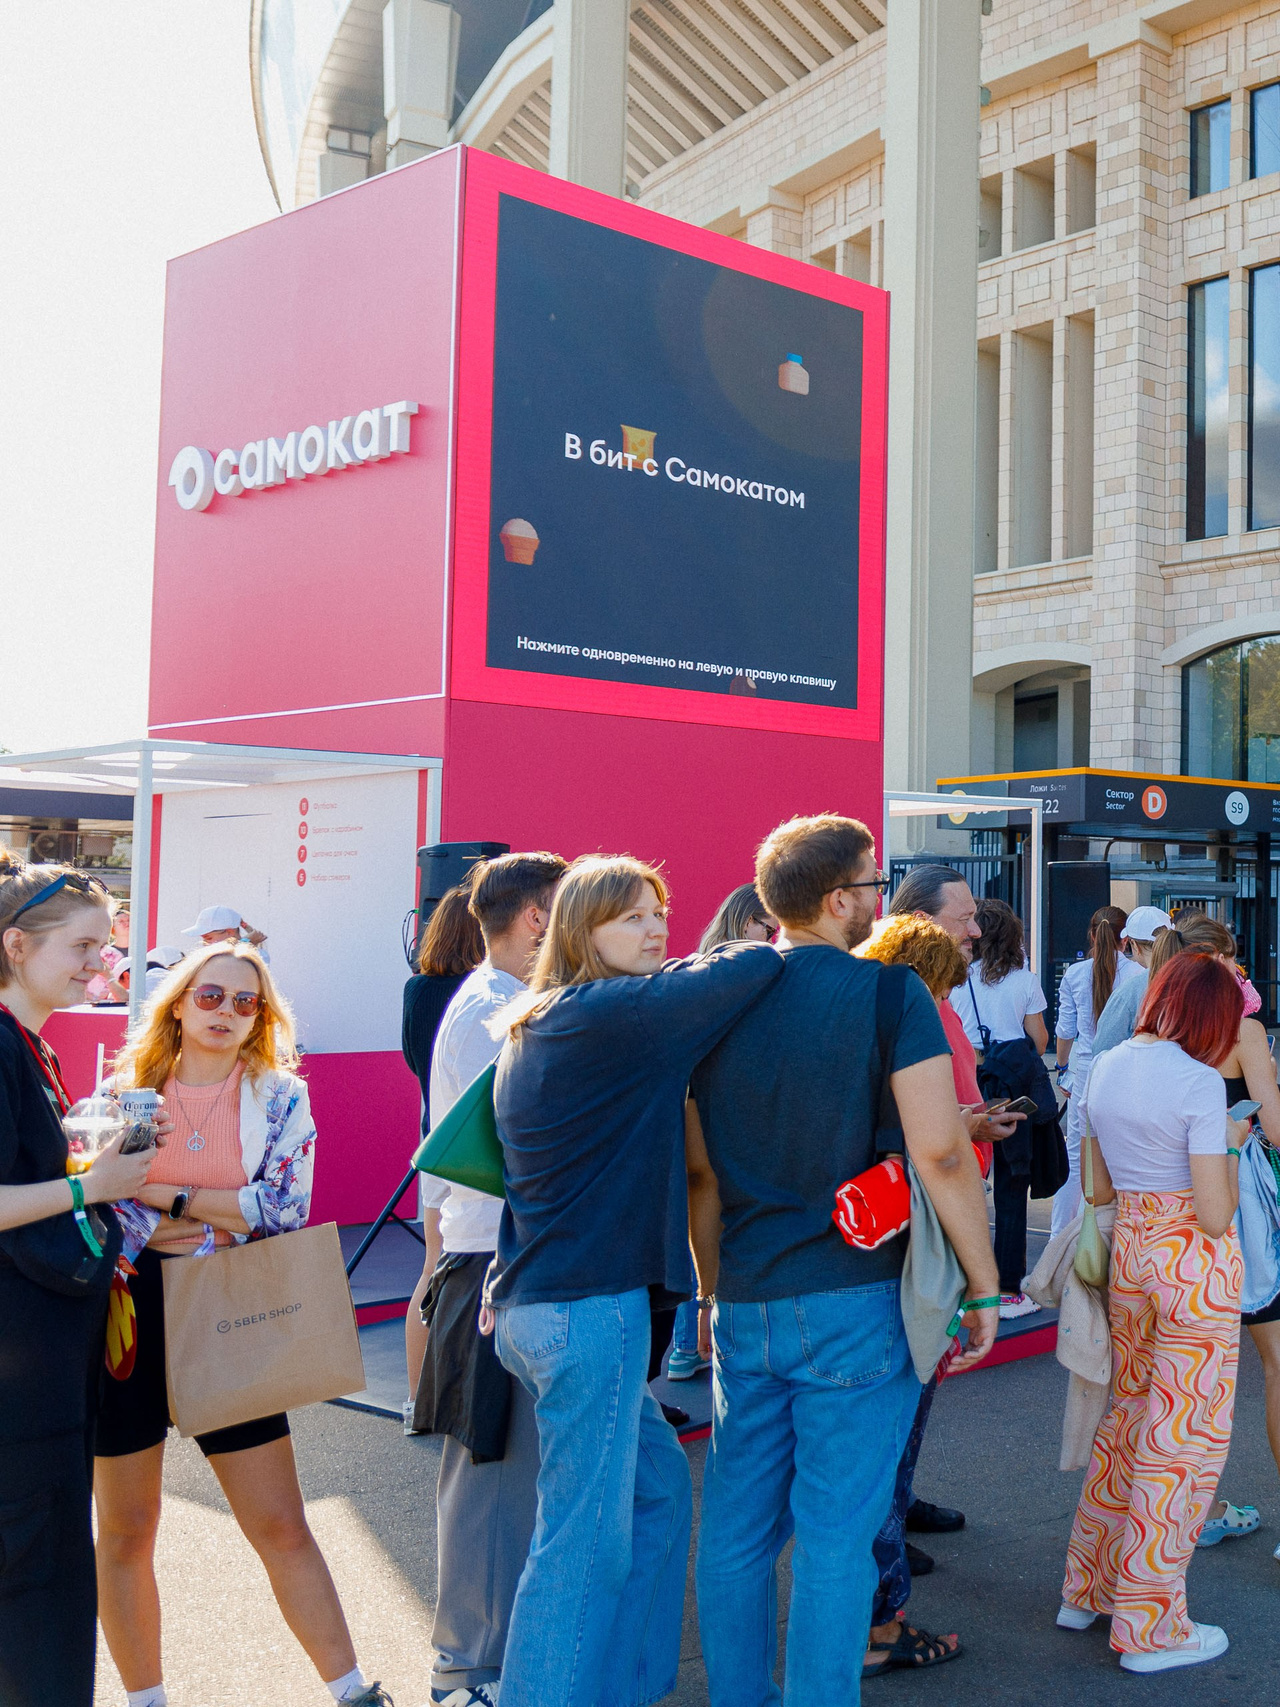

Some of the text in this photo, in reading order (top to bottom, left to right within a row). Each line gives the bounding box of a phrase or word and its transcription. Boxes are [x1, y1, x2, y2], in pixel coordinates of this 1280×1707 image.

[214, 400, 419, 497] самокат
[565, 432, 806, 509] В бит с Самокатом
[516, 635, 837, 691] Нажмите одновременно на левую и правую клавишу
[1029, 784, 1048, 793] Ложи
[1050, 784, 1068, 792] Sutes
[1105, 788, 1135, 802] Сектор
[1105, 802, 1126, 811] Sector
[1148, 792, 1163, 813] D
[1231, 801, 1244, 814] S9
[234, 1302, 303, 1328] SBER SHOP
